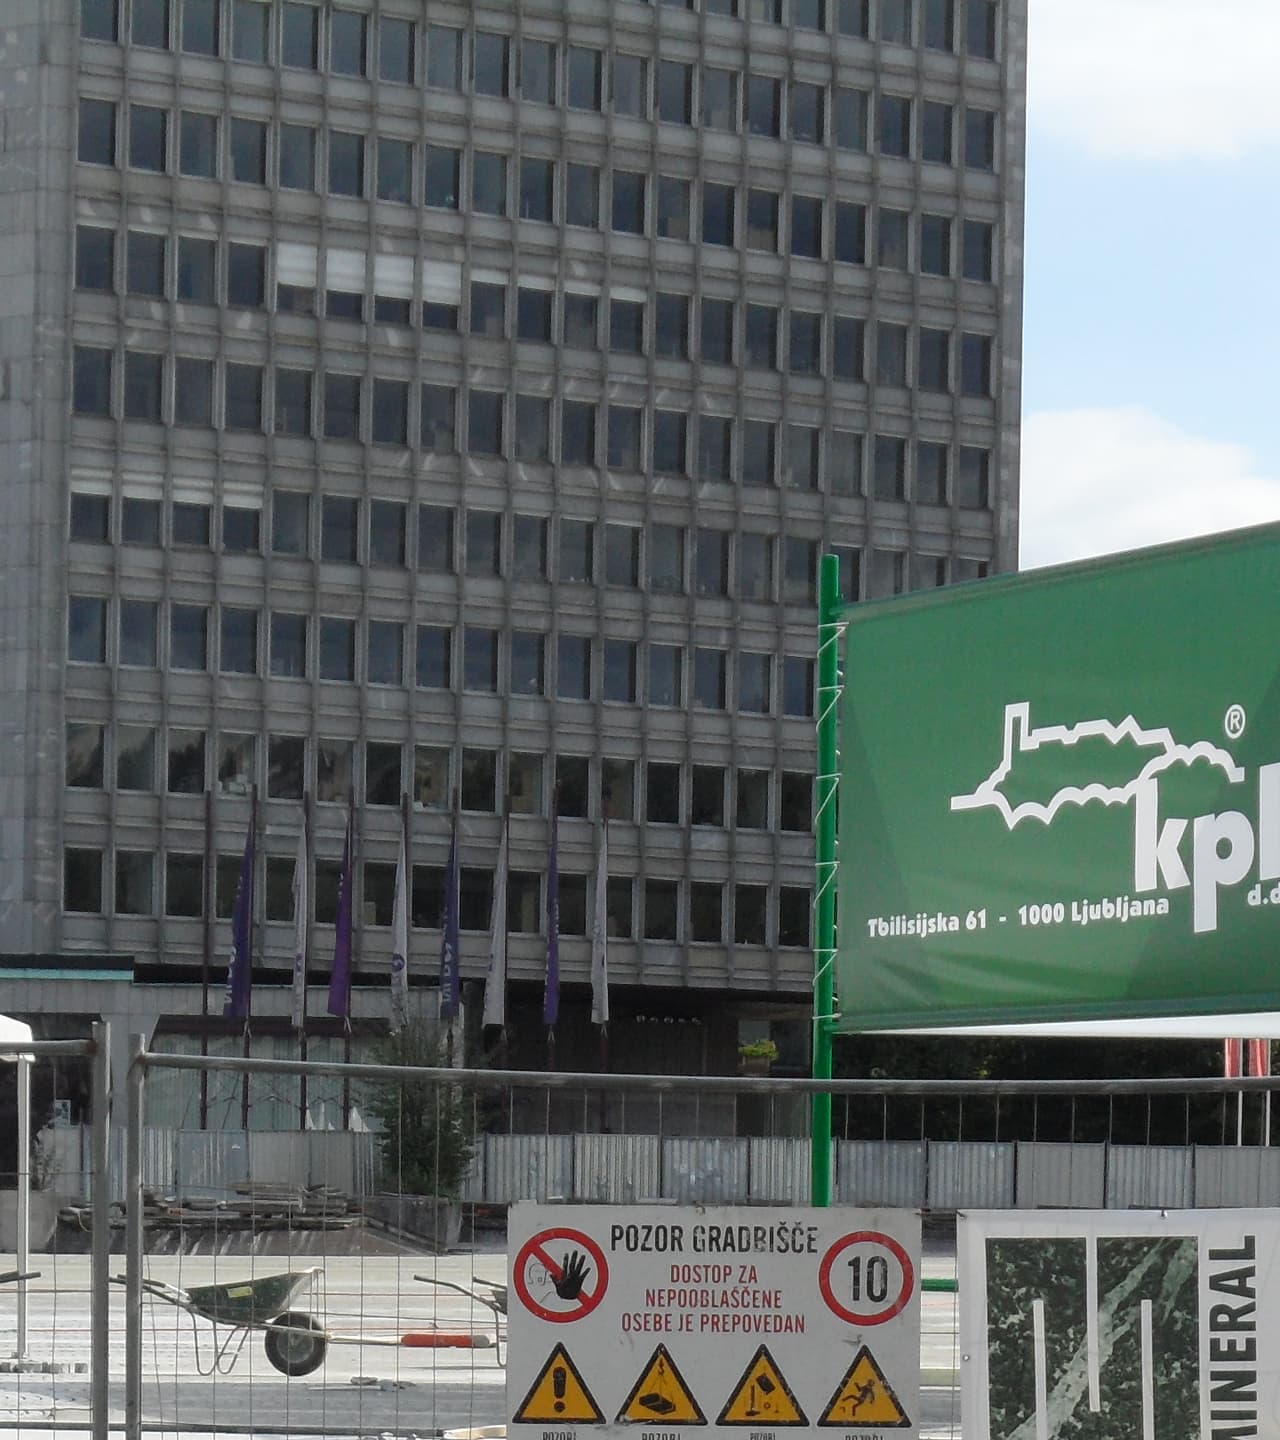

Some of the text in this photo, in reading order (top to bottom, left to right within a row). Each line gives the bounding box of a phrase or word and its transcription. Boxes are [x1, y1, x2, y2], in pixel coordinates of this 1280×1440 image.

[868, 911, 959, 938] Tbilisijska
[965, 908, 987, 930] 61
[1019, 902, 1064, 926] 1000
[1071, 897, 1170, 922] Ljubljana
[611, 1221, 819, 1254] POZOR GRADBIŠČE
[670, 1264, 758, 1284] DOSTOP ZA
[848, 1255, 889, 1304] 10
[621, 1313, 806, 1334] OSEBE JE PREPOVEDAN
